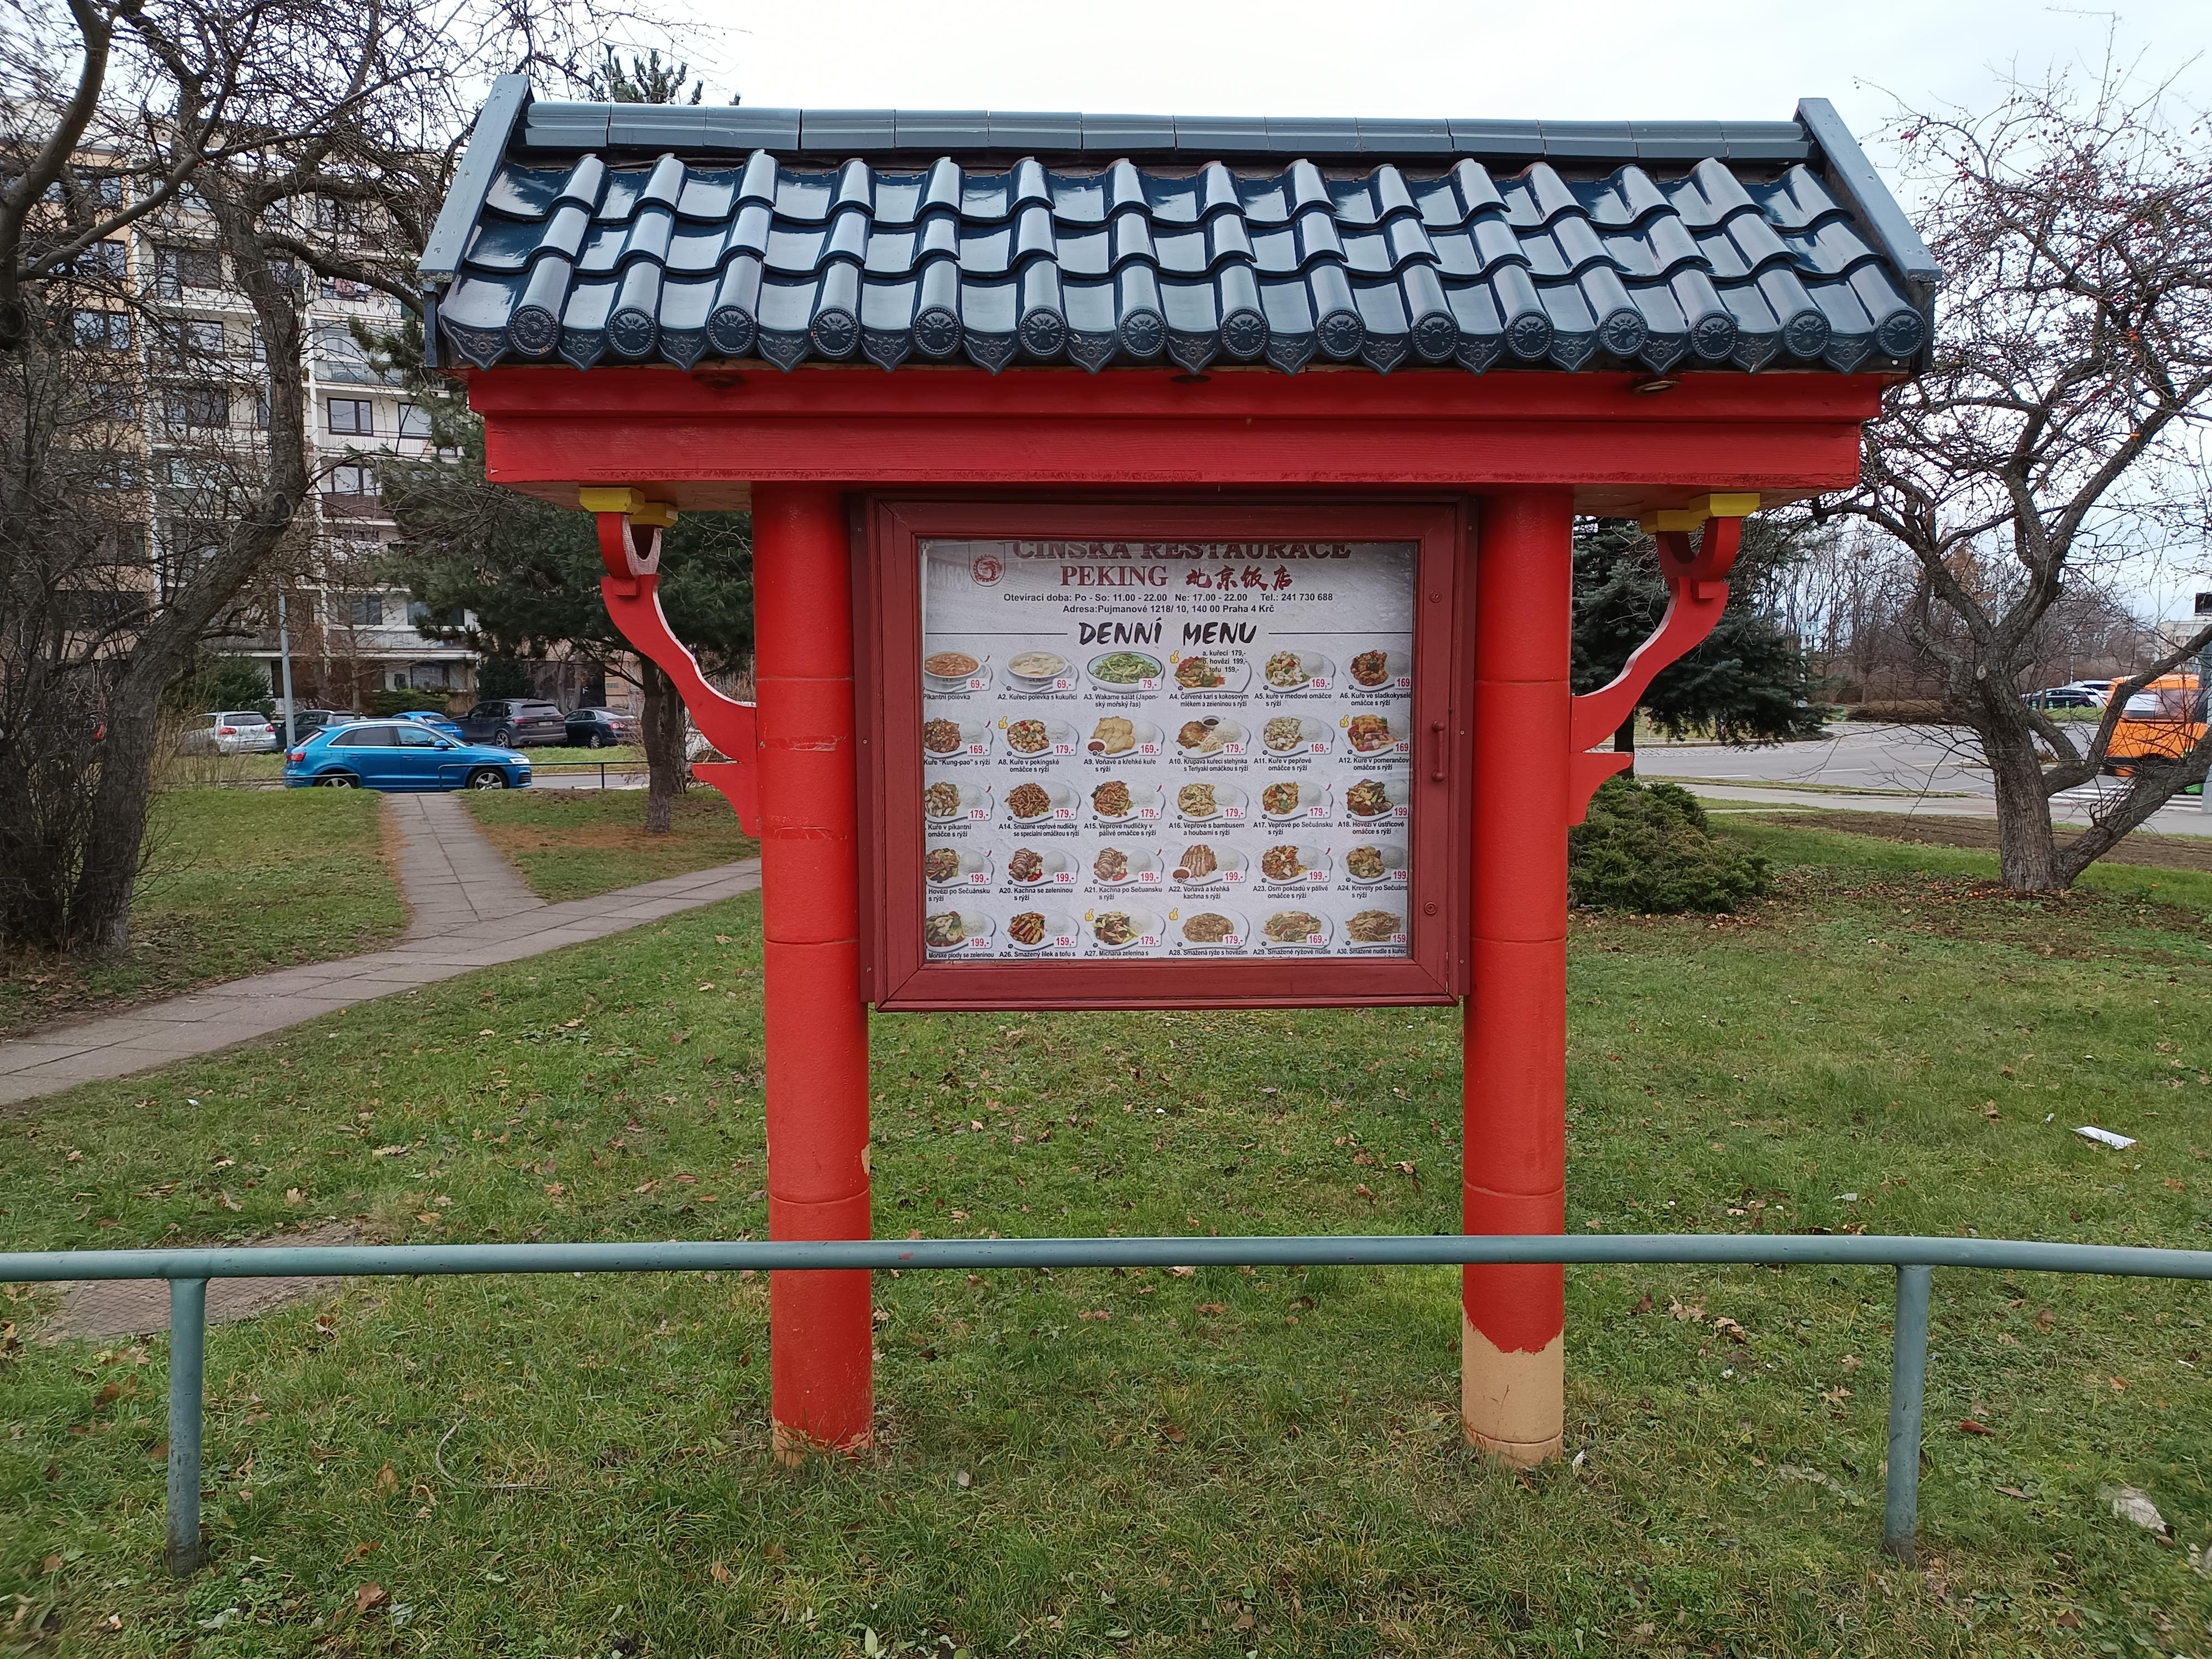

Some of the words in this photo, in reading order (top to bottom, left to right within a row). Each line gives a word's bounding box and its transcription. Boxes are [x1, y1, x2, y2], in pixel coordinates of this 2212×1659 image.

[1061, 565, 1168, 587] PEKING
[1185, 564, 1294, 592] 北京饭店
[1004, 593, 1044, 602] Otevírací
[1046, 593, 1072, 602] doba:
[1074, 593, 1087, 602] Po
[1095, 593, 1109, 602] So:
[1113, 593, 1135, 602] 11.00
[1144, 593, 1167, 602] 22.00
[1175, 593, 1190, 602] Ne:
[1192, 593, 1216, 602] 17.00
[1281, 593, 1296, 601] 241
[1299, 593, 1315, 601] 730
[1317, 593, 1333, 601] 688
[1062, 605, 1147, 614] Adresa:Pujmanové
[1150, 604, 1174, 613] 1218/
[1176, 605, 1189, 614] 10,
[1223, 604, 1249, 613] Praha
[1250, 604, 1256, 613] 4
[1259, 604, 1274, 613] Krč
[1078, 617, 1162, 645] DENNÍ
[1182, 622, 1258, 646] MENU
[971, 679, 985, 690] 69,-
[1057, 679, 1071, 690] 69,-
[1143, 679, 1157, 690] 79,-
[1311, 679, 1330, 689] 169,-
[969, 745, 988, 754] 169,-
[1055, 745, 1074, 754] 179,-
[1140, 745, 1159, 754] 169,-
[1225, 744, 1244, 753] 179,-
[1311, 744, 1329, 753] 169,-
[969, 810, 989, 819] 179,-
[1056, 809, 1074, 819] 179,-
[1140, 809, 1159, 819] 179,-
[1225, 808, 1244, 818] 179,-
[1310, 808, 1328, 818] 179,-
[971, 874, 989, 884] 199,-
[1056, 873, 1074, 883] 199,-
[1140, 873, 1159, 883] 199,-
[1224, 872, 1243, 882] 199,-
[1310, 872, 1328, 881] 199,-
[971, 937, 989, 948] 199,-
[1056, 937, 1074, 947] 159,-
[1140, 937, 1159, 946] 179,-
[1224, 936, 1243, 945] 179,-
[1309, 935, 1327, 945] 169,-
